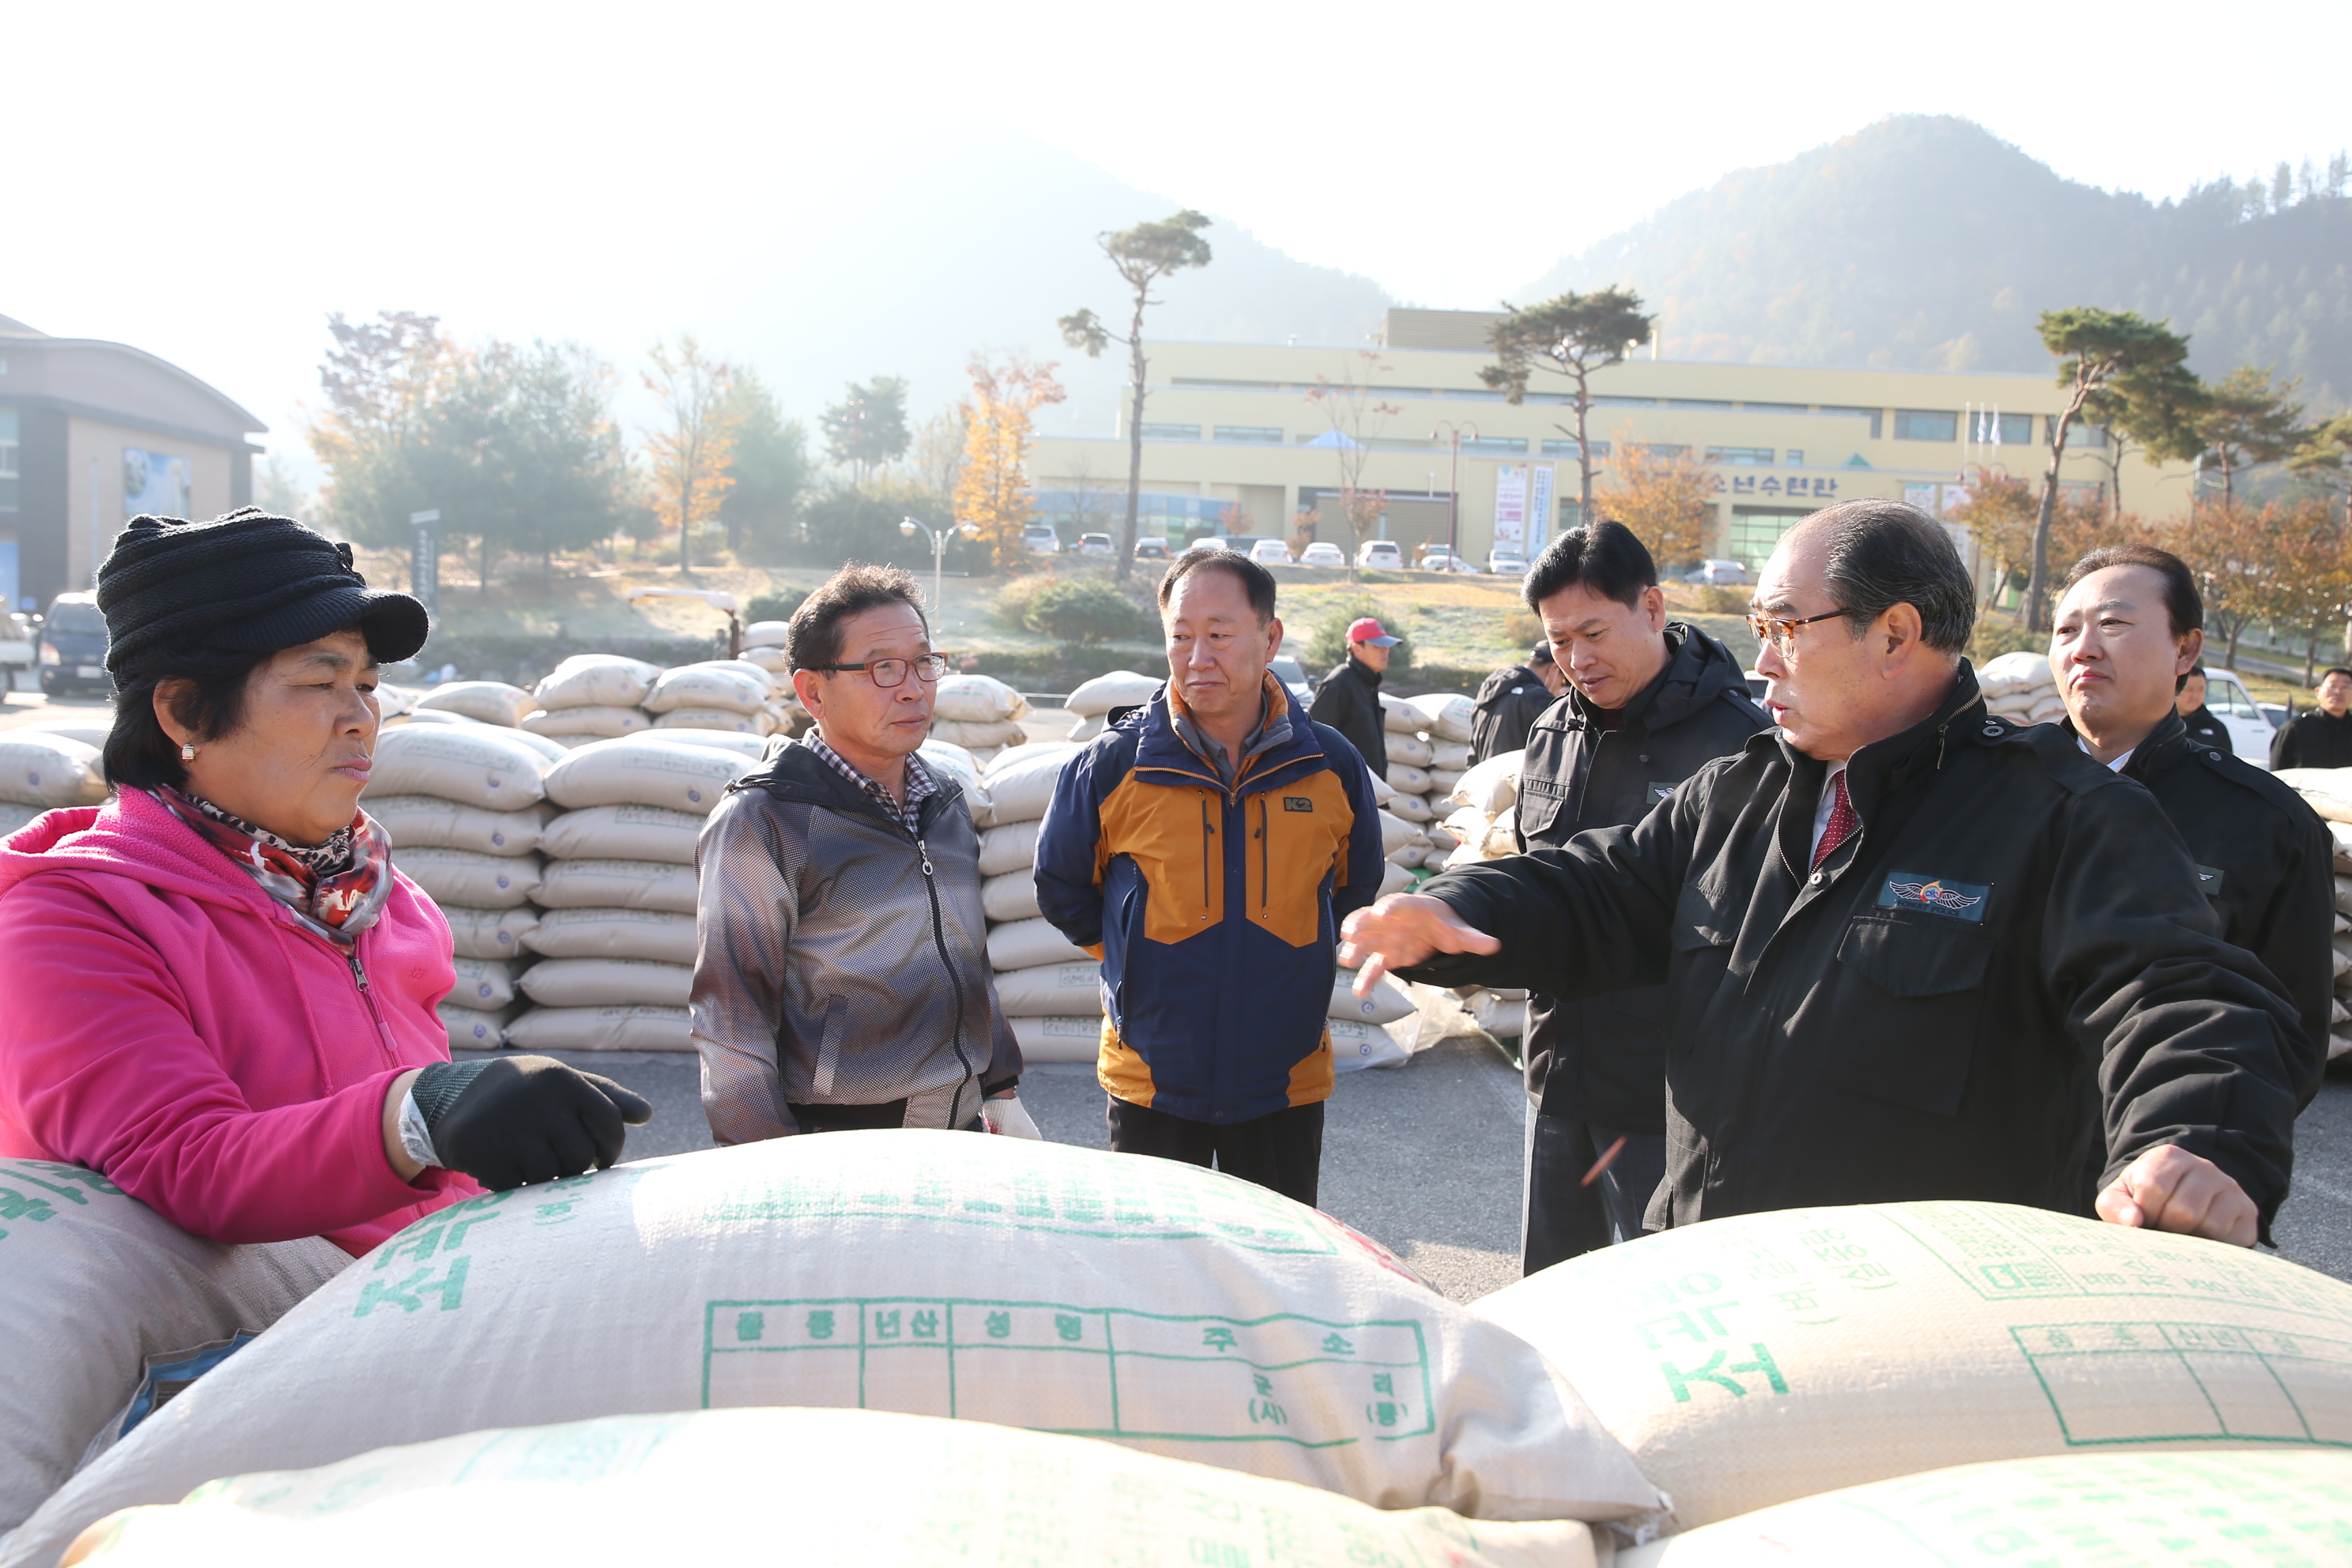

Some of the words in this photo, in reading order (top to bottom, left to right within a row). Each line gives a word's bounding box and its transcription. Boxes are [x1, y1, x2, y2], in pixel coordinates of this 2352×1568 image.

[1284, 798, 1312, 811] K2
[1897, 900, 1929, 911] FOREST
[1931, 906, 1961, 917] POLICE
